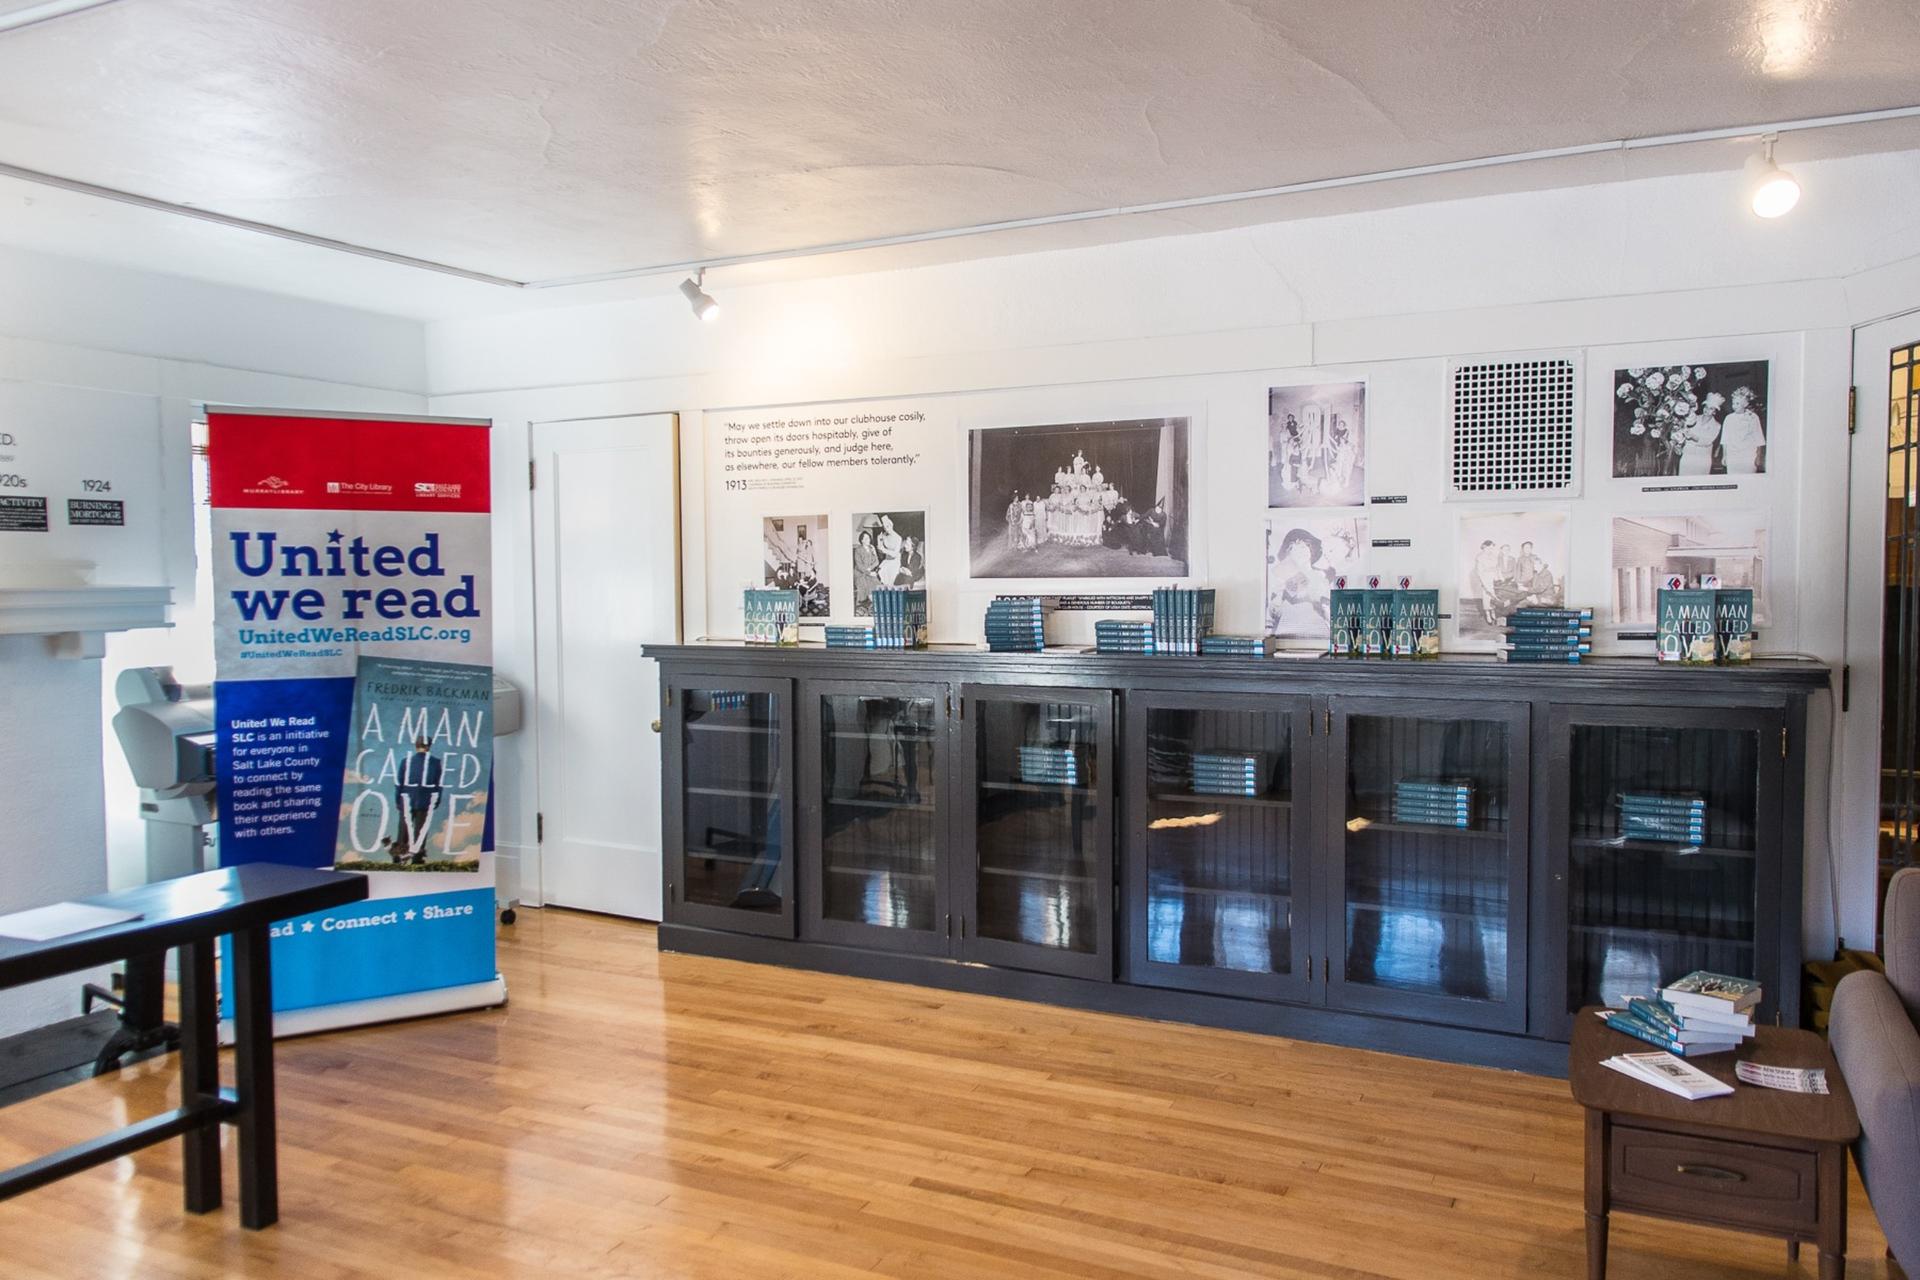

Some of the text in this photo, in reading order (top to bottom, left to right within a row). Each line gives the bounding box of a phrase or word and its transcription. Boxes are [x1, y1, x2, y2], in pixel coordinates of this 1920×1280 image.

[762, 420, 786, 429] settle
[788, 419, 812, 428] down
[814, 417, 832, 426] into
[833, 417, 848, 425] our
[850, 413, 897, 424] clubhouse
[898, 411, 926, 423] cosily,
[724, 426, 892, 446] throw open its doors hospitably, give of
[724, 442, 894, 459] its bounties generously, and judge here,
[724, 463, 735, 472] as
[736, 461, 780, 472] elsewhere,
[782, 461, 796, 470] our
[798, 458, 825, 468] fellow
[826, 456, 869, 467] members
[82, 479, 111, 492] 1924
[341, 482, 393, 492] The City Library
[725, 480, 747, 491] 1913
[70, 501, 111, 510] BURNING
[71, 510, 121, 520] MORTGAGE
[230, 529, 445, 577] United
[231, 575, 480, 621] we read
[766, 600, 795, 612] A MAN
[911, 602, 926, 613] MAN
[1337, 603, 1362, 616] A MA
[1370, 603, 1393, 616] A MA
[1400, 603, 1435, 617] A MAN
[1666, 605, 1710, 619] A MAN
[1716, 604, 1748, 619] MAN
[1369, 616, 1392, 629] CALL
[1398, 617, 1436, 630] CALLED
[1664, 620, 1711, 634] CALLED
[239, 626, 471, 645] UnitedWeReadSLC.org
[1337, 629, 1361, 649] OV
[1369, 629, 1393, 650] OV
[240, 649, 343, 659] #UnitedWeReadSLC
[367, 681, 490, 701] FREDRIK BACKMAN
[231, 716, 316, 729] United We Read
[362, 702, 484, 748] A MAN
[232, 730, 329, 742] SLC is an initiative
[232, 743, 308, 756] for everyone in
[232, 757, 320, 770] Salt Lake County
[355, 748, 481, 788] CALLED
[233, 771, 303, 784] to connect by
[233, 784, 321, 797] reading the same
[233, 797, 322, 811] book and sharing
[234, 811, 317, 825] their experience
[350, 789, 476, 855] OVE
[234, 826, 295, 838] with others.
[270, 905, 474, 938] ad Connect Share
